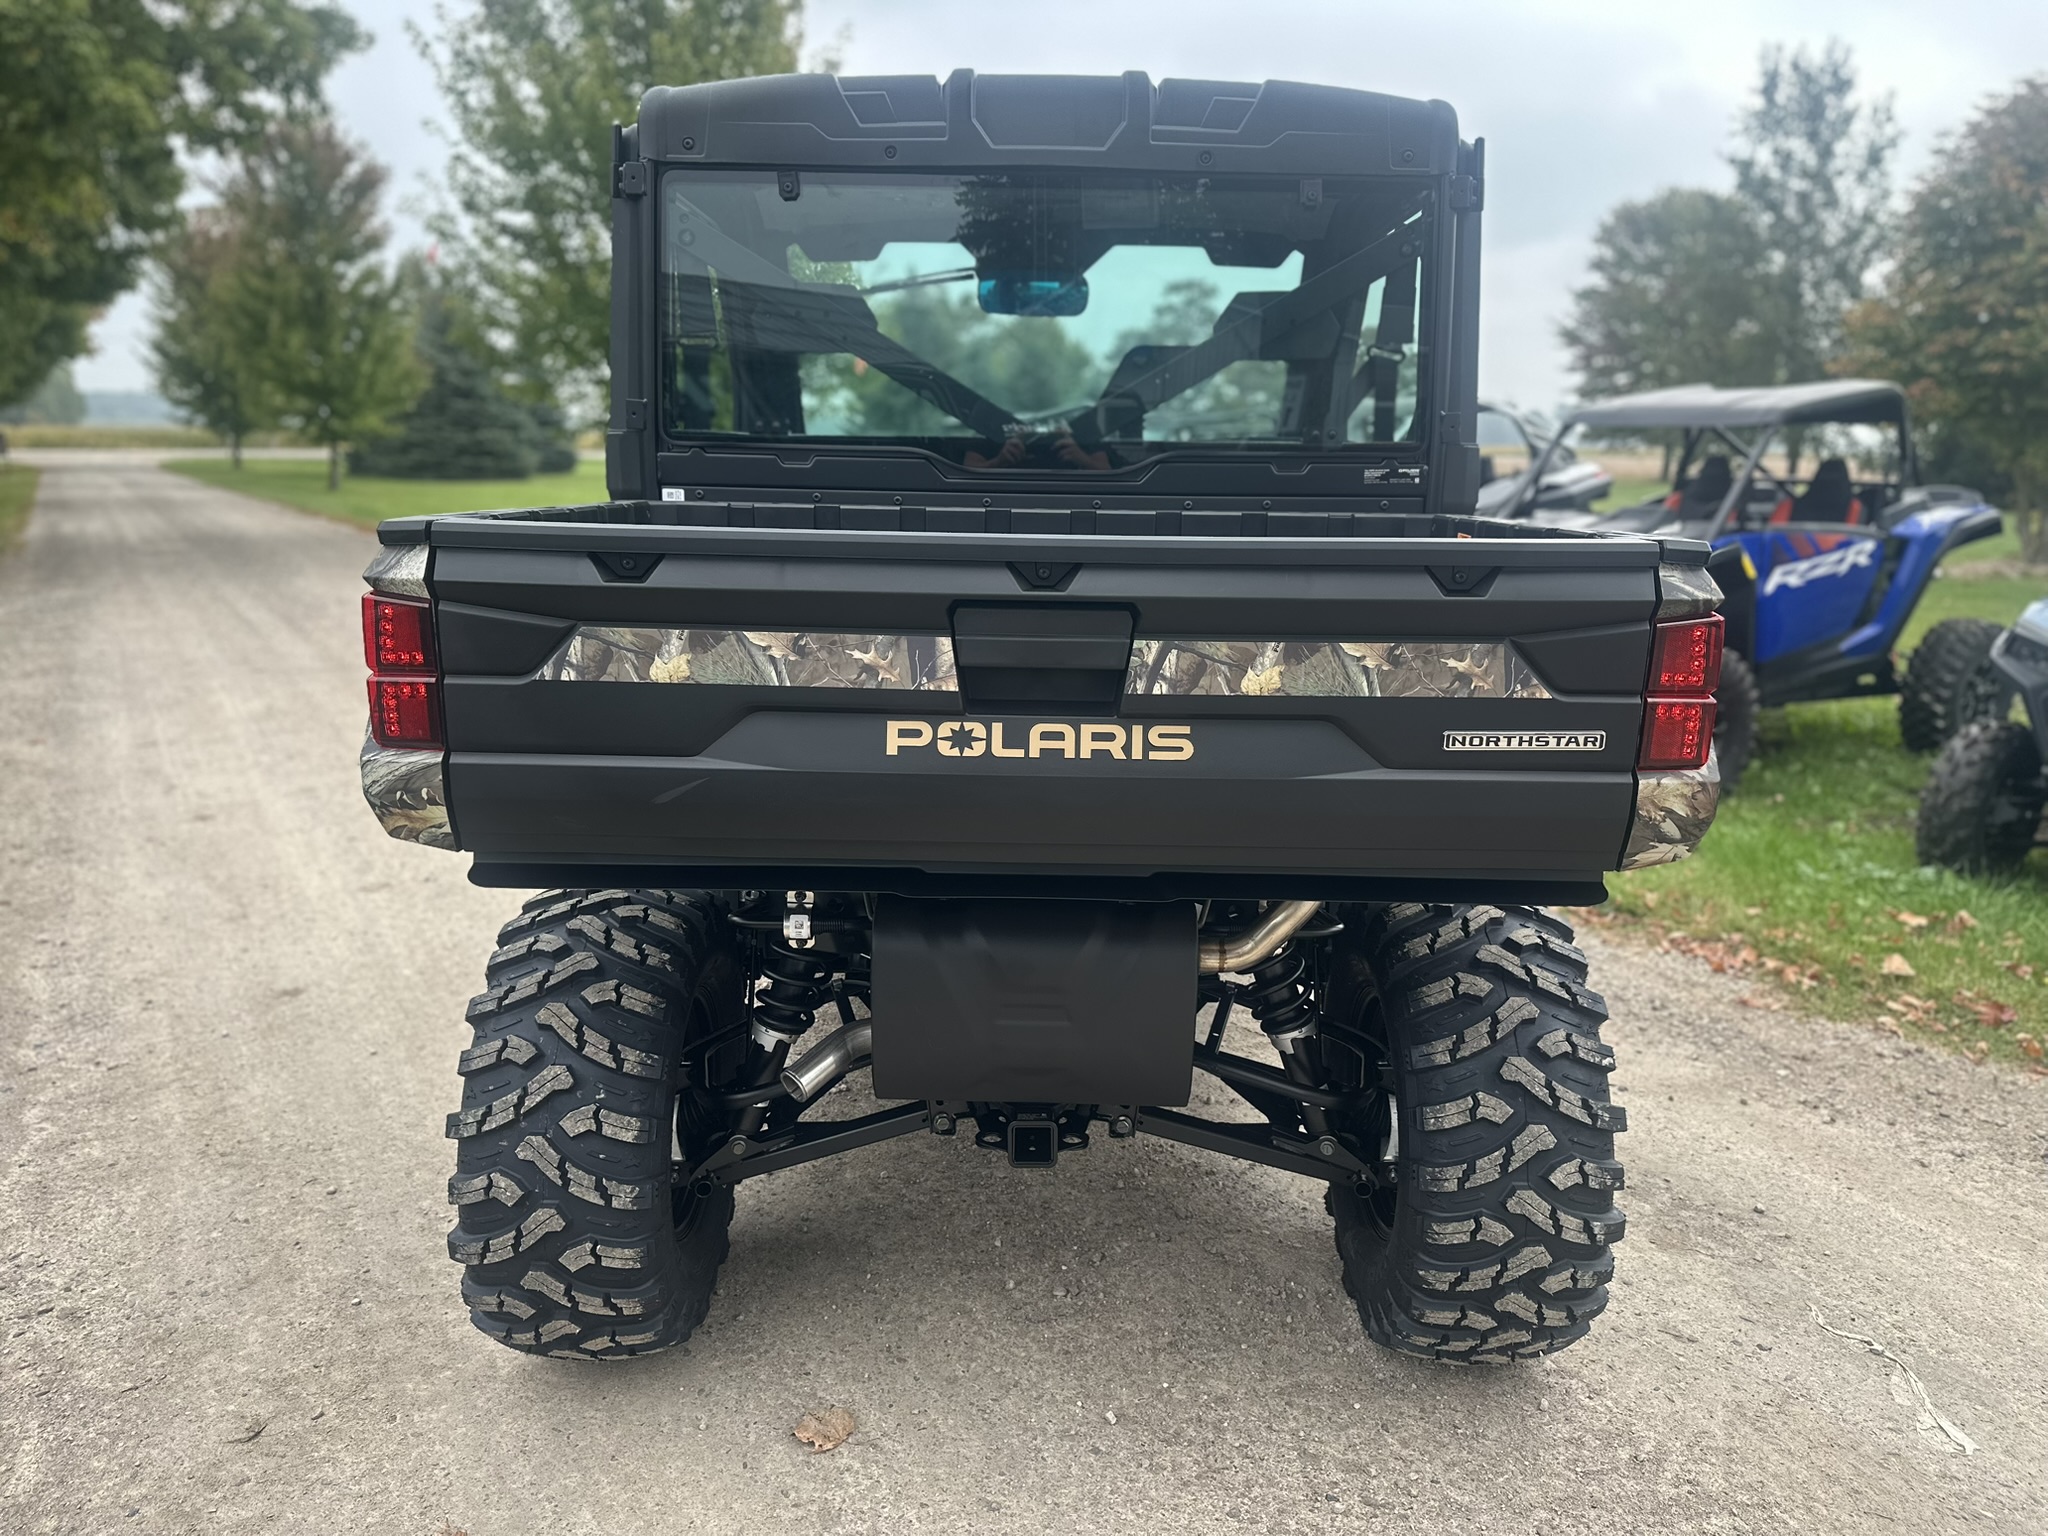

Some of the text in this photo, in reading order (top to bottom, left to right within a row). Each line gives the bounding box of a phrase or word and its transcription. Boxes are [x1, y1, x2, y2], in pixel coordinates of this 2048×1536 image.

[1763, 540, 1877, 596] RZR
[886, 720, 1194, 761] POLARIS
[1450, 734, 1600, 747] NORTHSTAR
